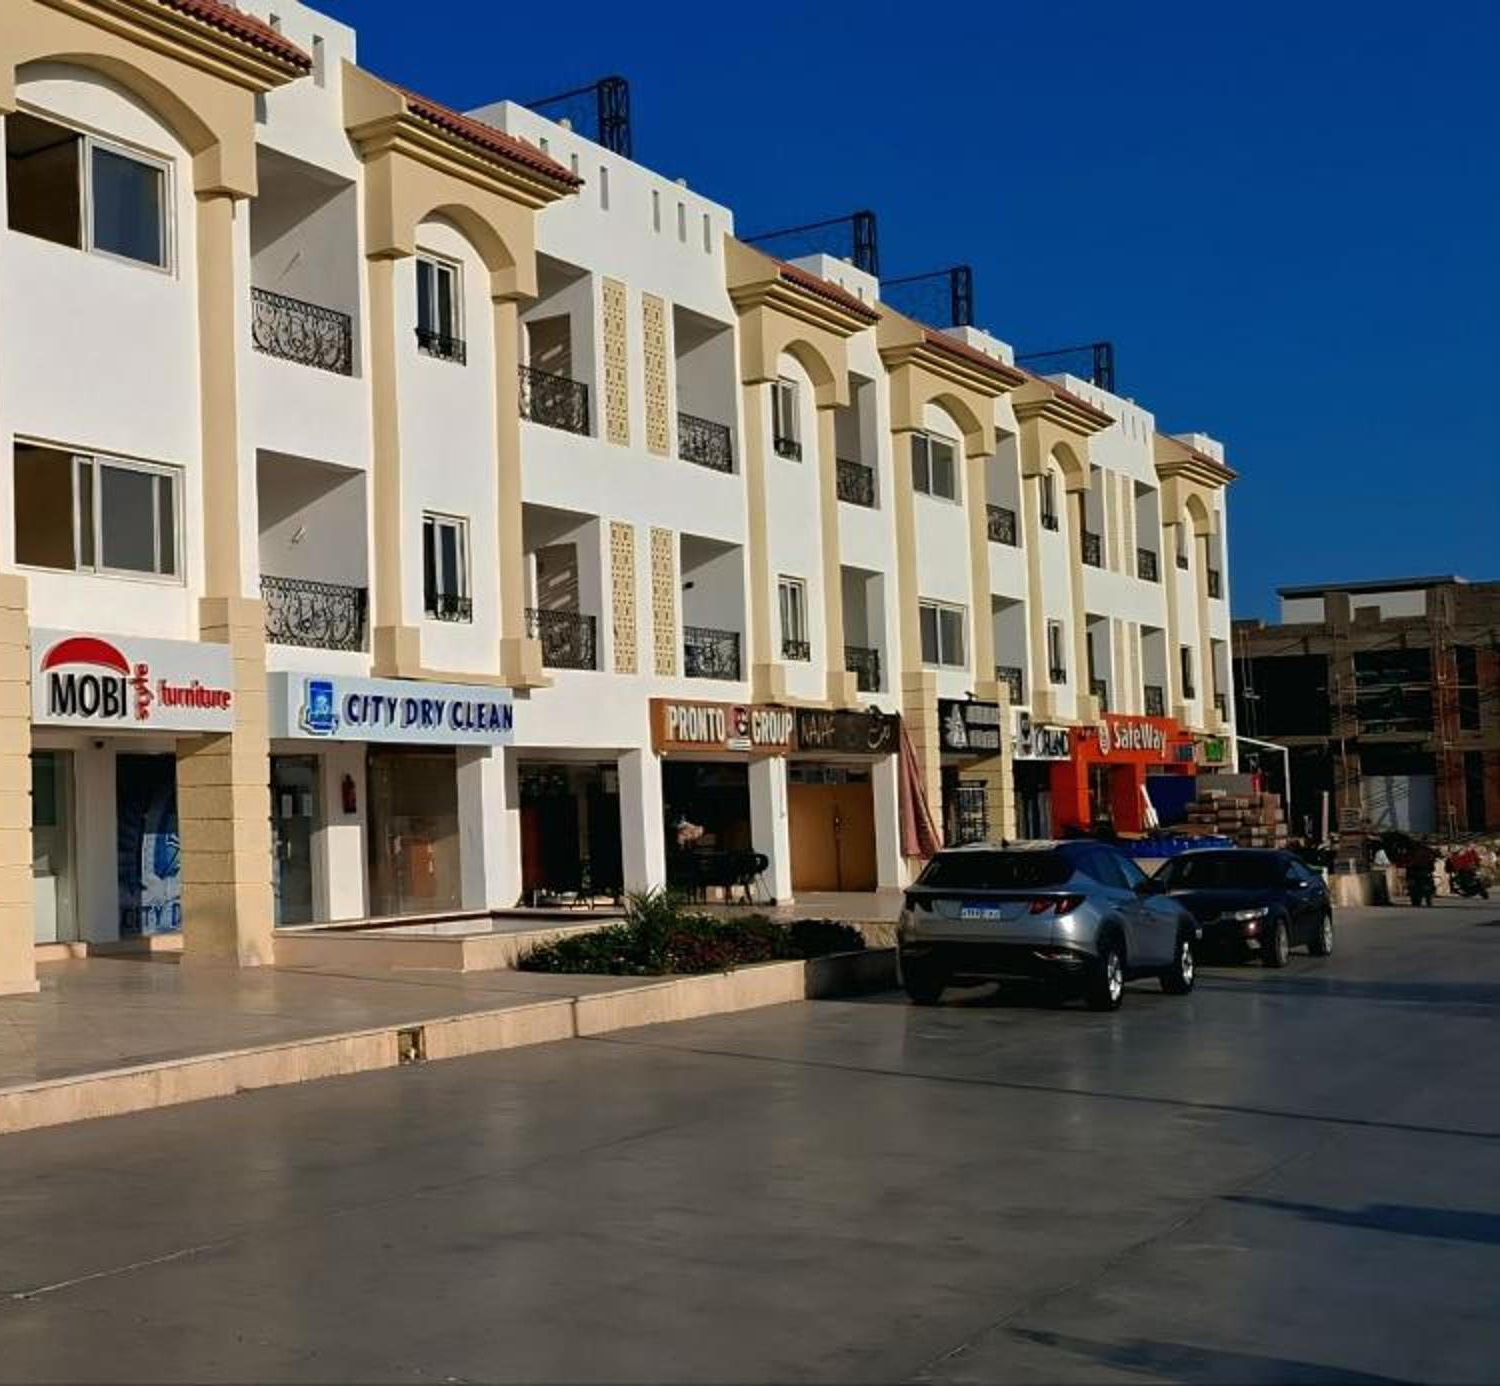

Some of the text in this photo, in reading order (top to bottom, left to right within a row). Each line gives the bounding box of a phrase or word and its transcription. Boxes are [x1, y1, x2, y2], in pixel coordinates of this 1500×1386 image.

[49, 671, 128, 718] MOBI
[130, 662, 154, 721] style
[158, 679, 232, 710] furniture
[345, 693, 513, 732] CITY DRY CLEAN
[666, 705, 726, 742] PRONTO
[751, 708, 793, 744] GROUP
